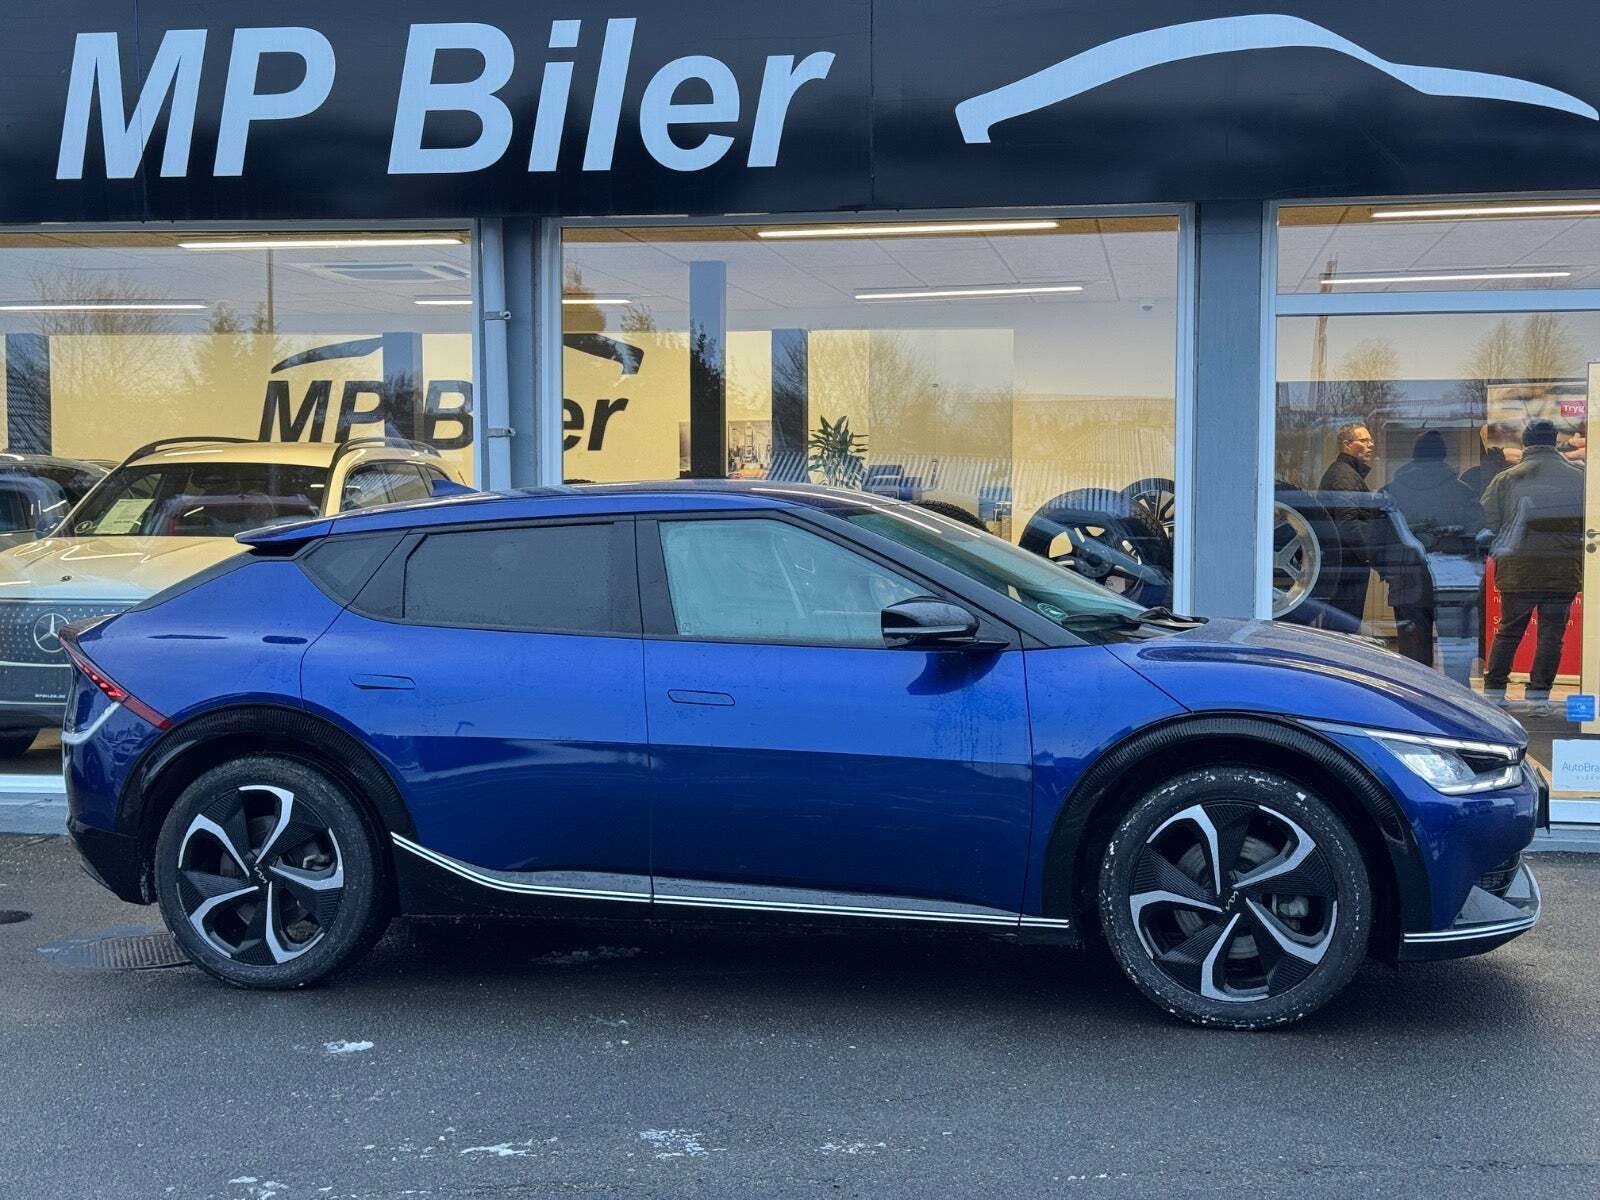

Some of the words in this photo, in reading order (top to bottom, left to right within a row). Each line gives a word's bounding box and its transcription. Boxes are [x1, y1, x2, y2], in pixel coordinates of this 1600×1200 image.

[56, 26, 335, 180] MP
[387, 17, 835, 175] Biler
[259, 379, 391, 445] MP
